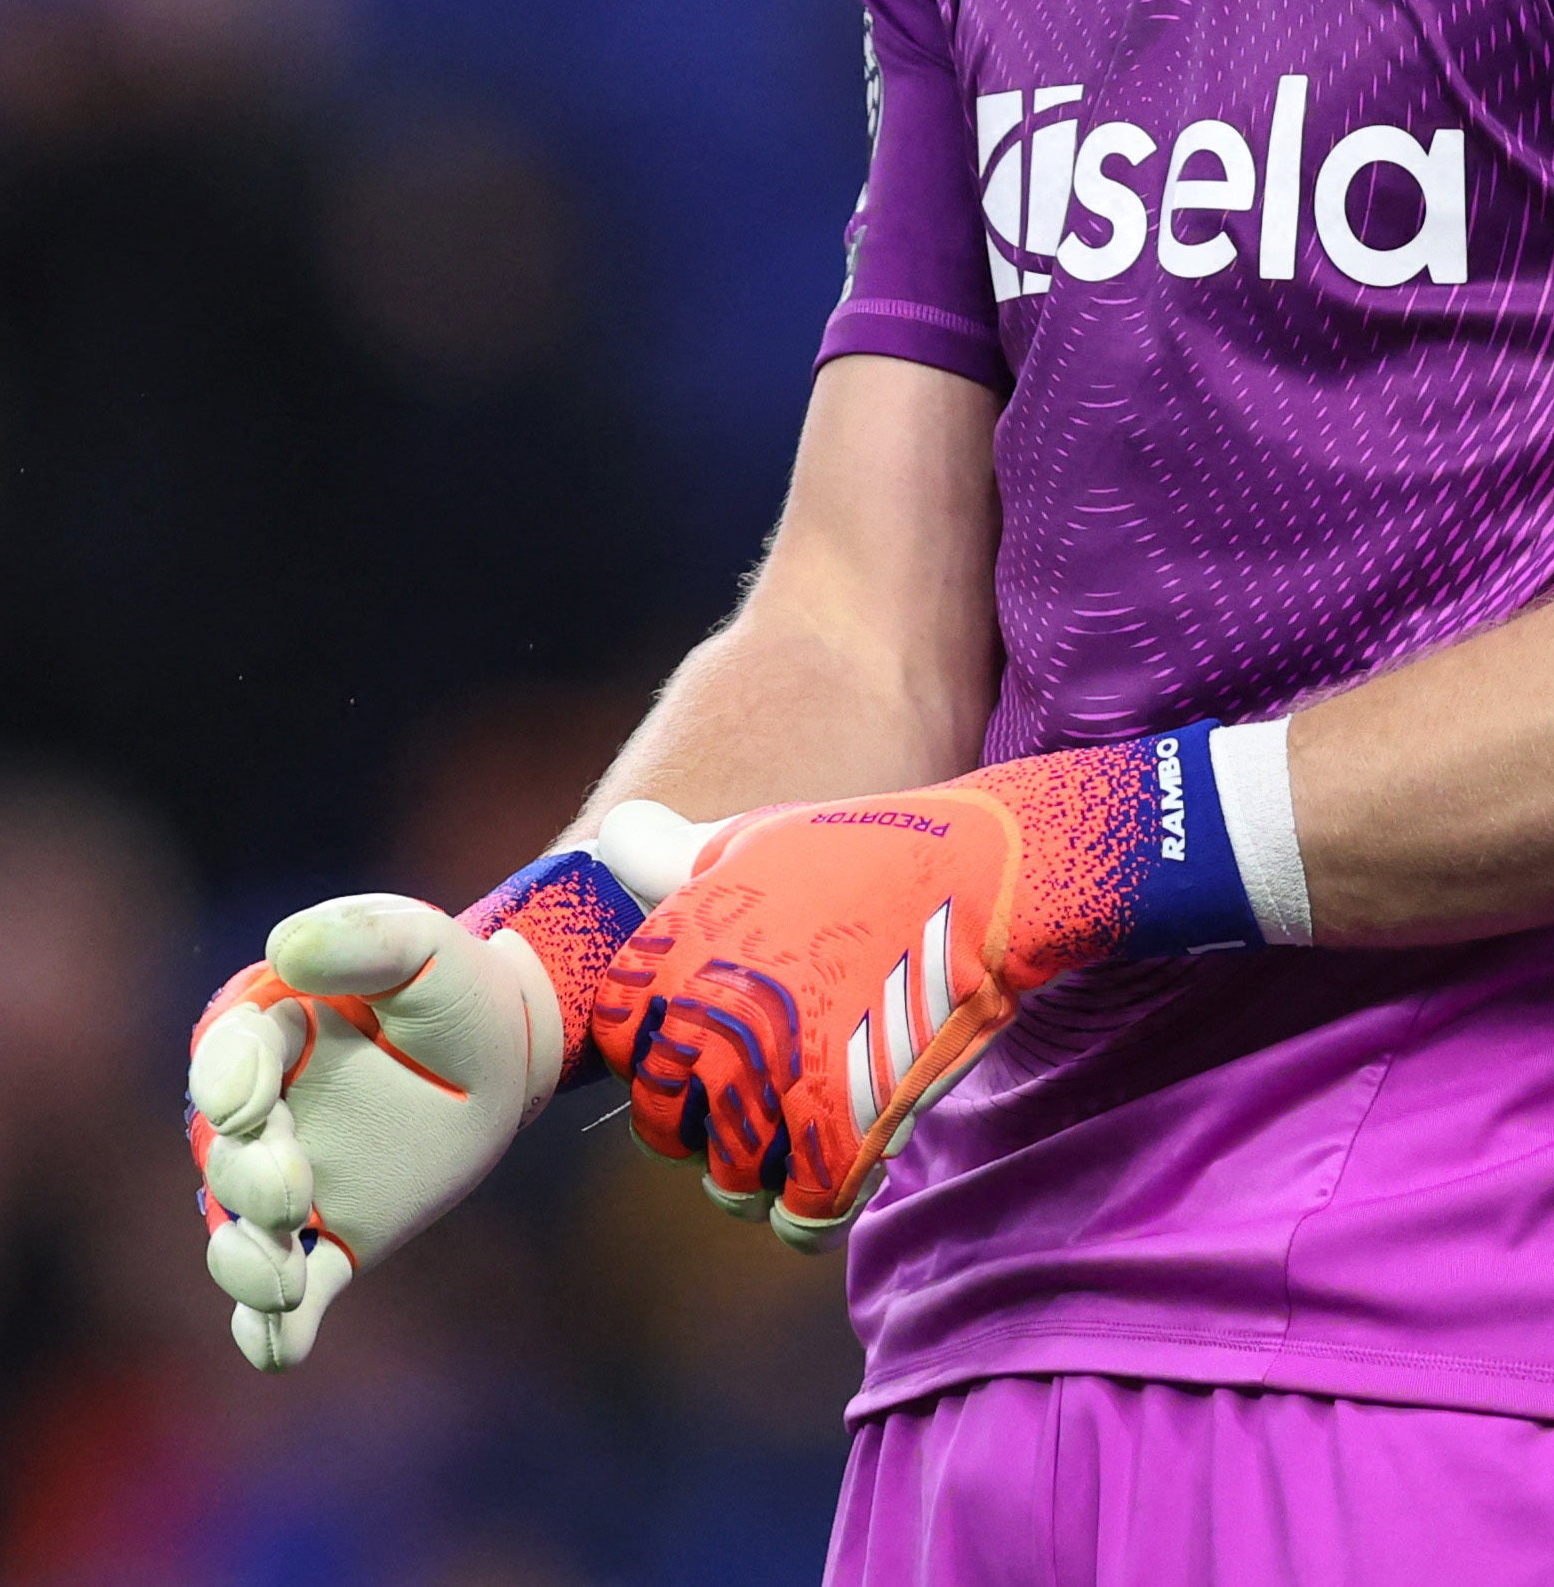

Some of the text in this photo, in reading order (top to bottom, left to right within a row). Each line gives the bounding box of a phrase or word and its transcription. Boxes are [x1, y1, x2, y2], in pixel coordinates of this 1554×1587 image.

[1056, 74, 1468, 287] sela
[810, 812, 951, 838] PREDATOR
[1156, 737, 1185, 861] RAMBO
